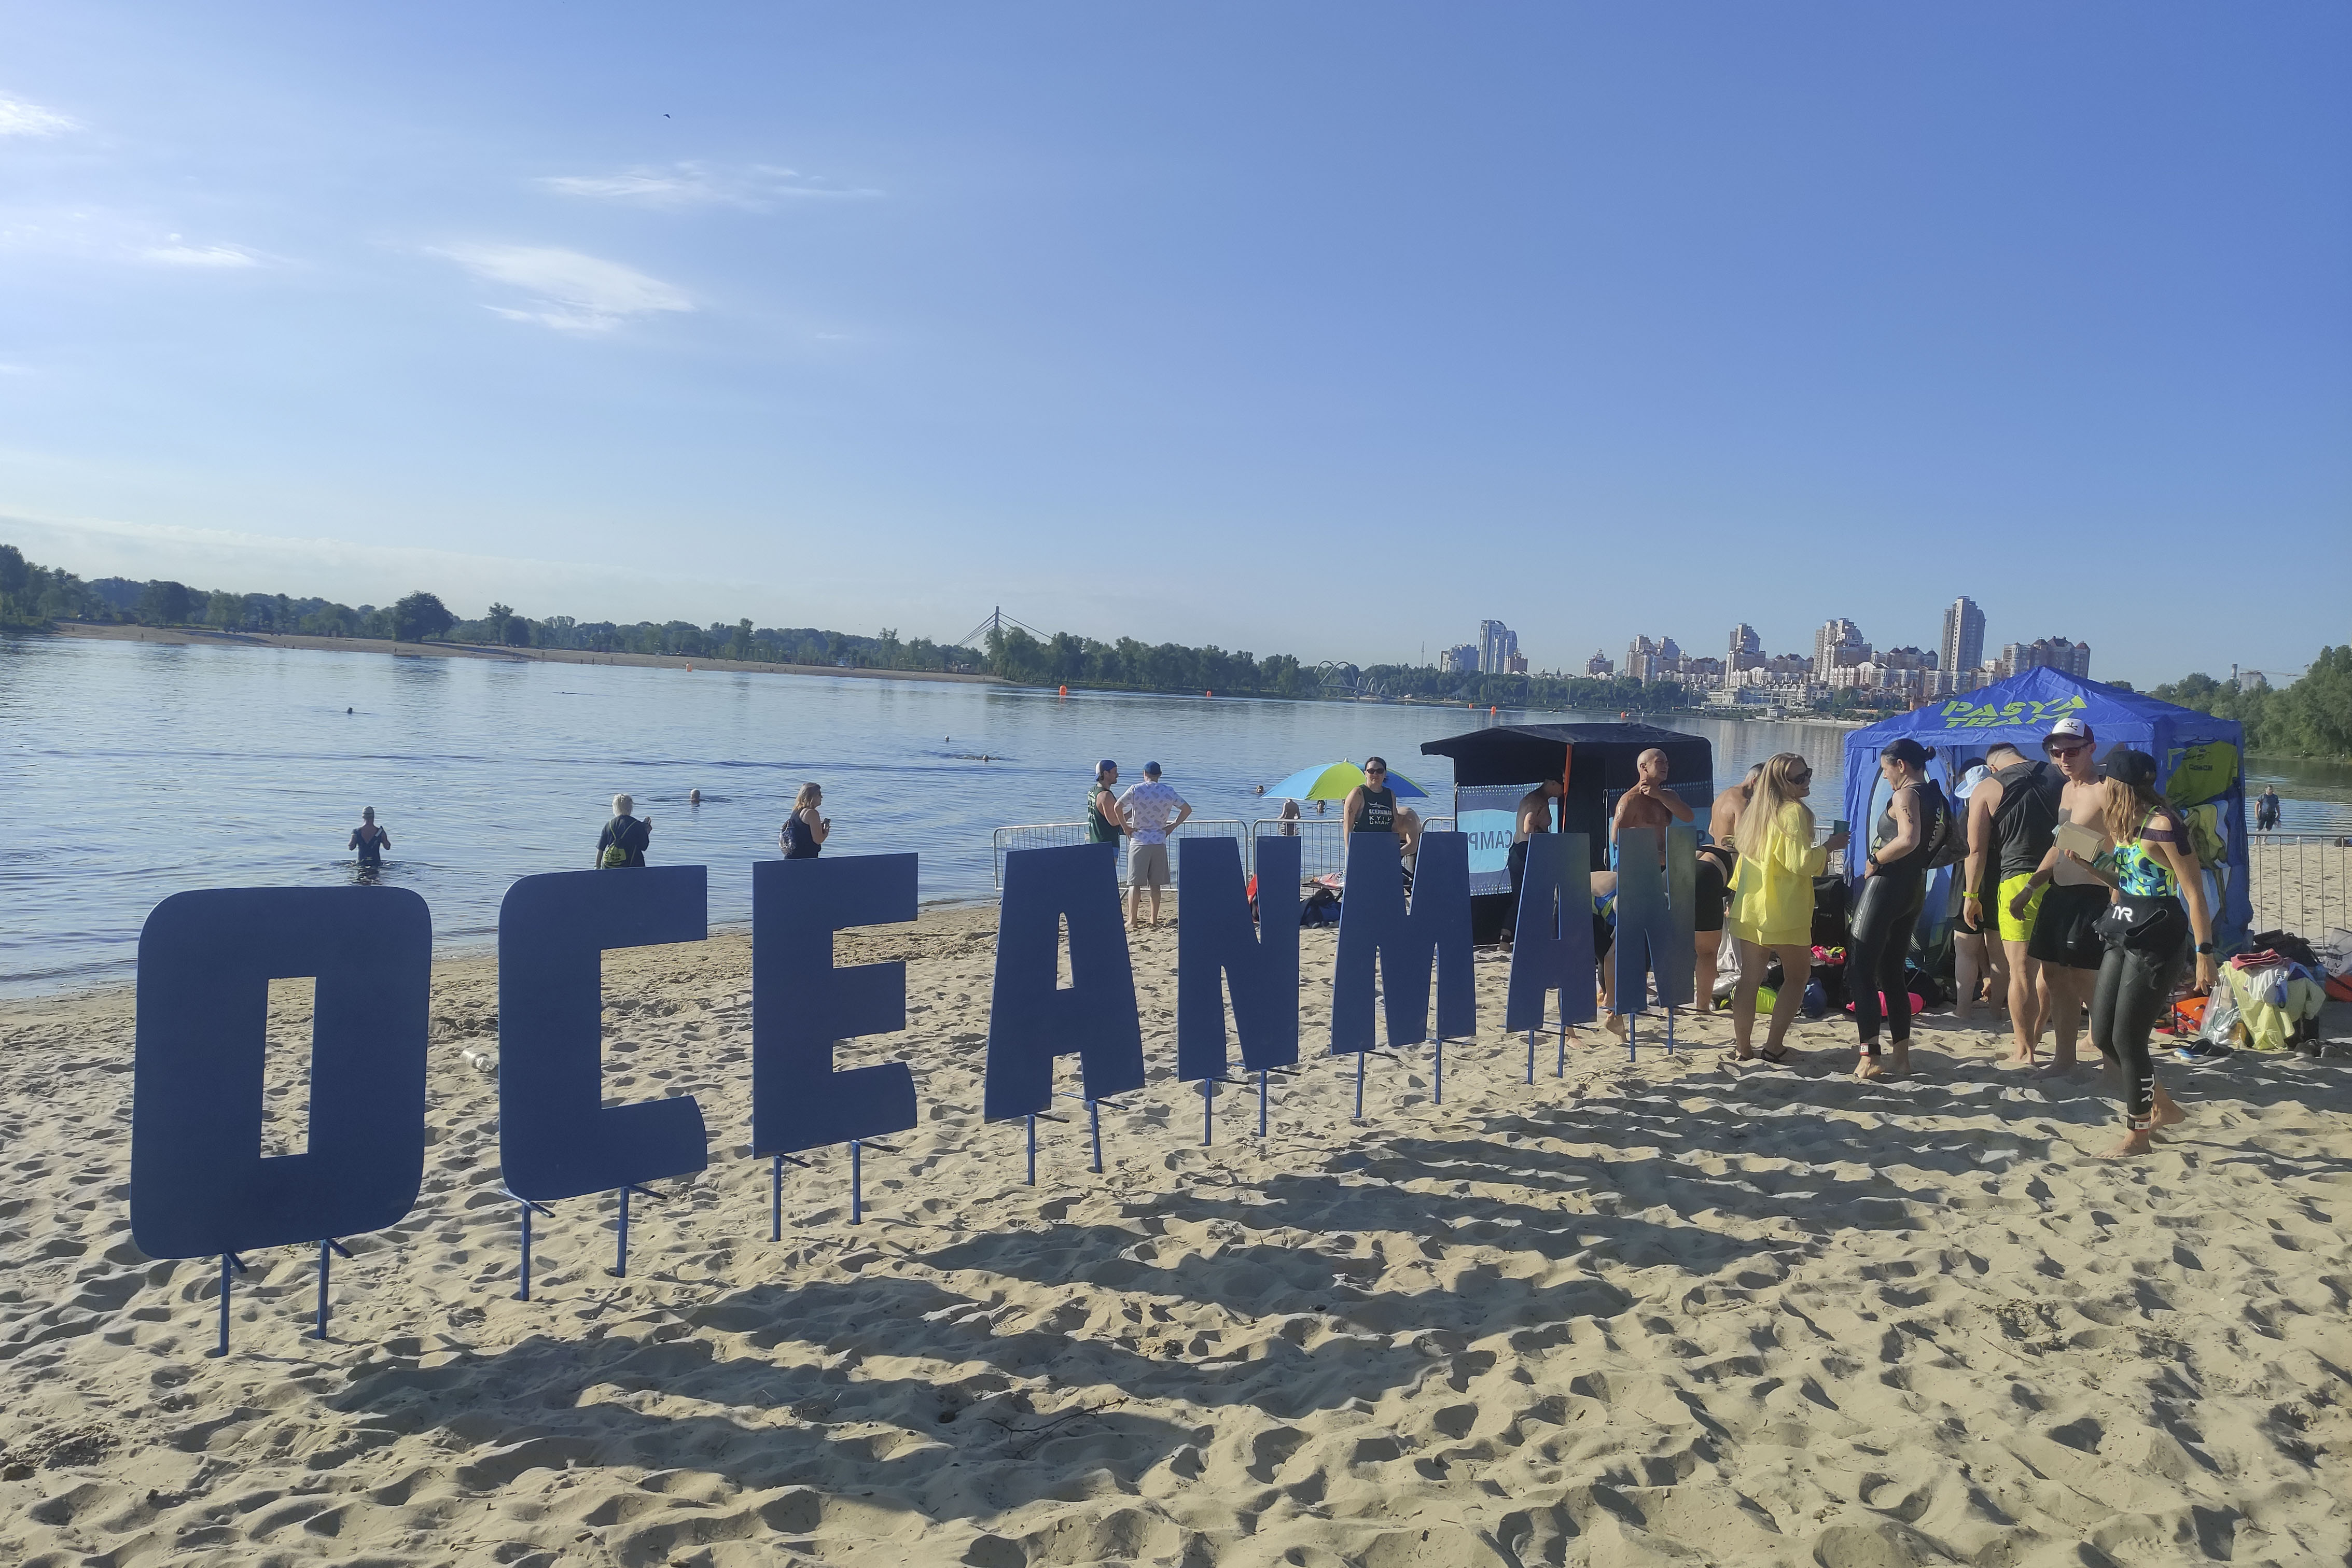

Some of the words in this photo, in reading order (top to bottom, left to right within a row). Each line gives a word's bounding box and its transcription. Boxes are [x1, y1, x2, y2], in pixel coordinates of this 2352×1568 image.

[1940, 695, 2087, 717] PASYA
[1945, 711, 2073, 728] TEAM
[2112, 906, 2133, 922] TYR
[130, 826, 1696, 1259] OCEANMAN
[2140, 1074, 2155, 1102] TYR
